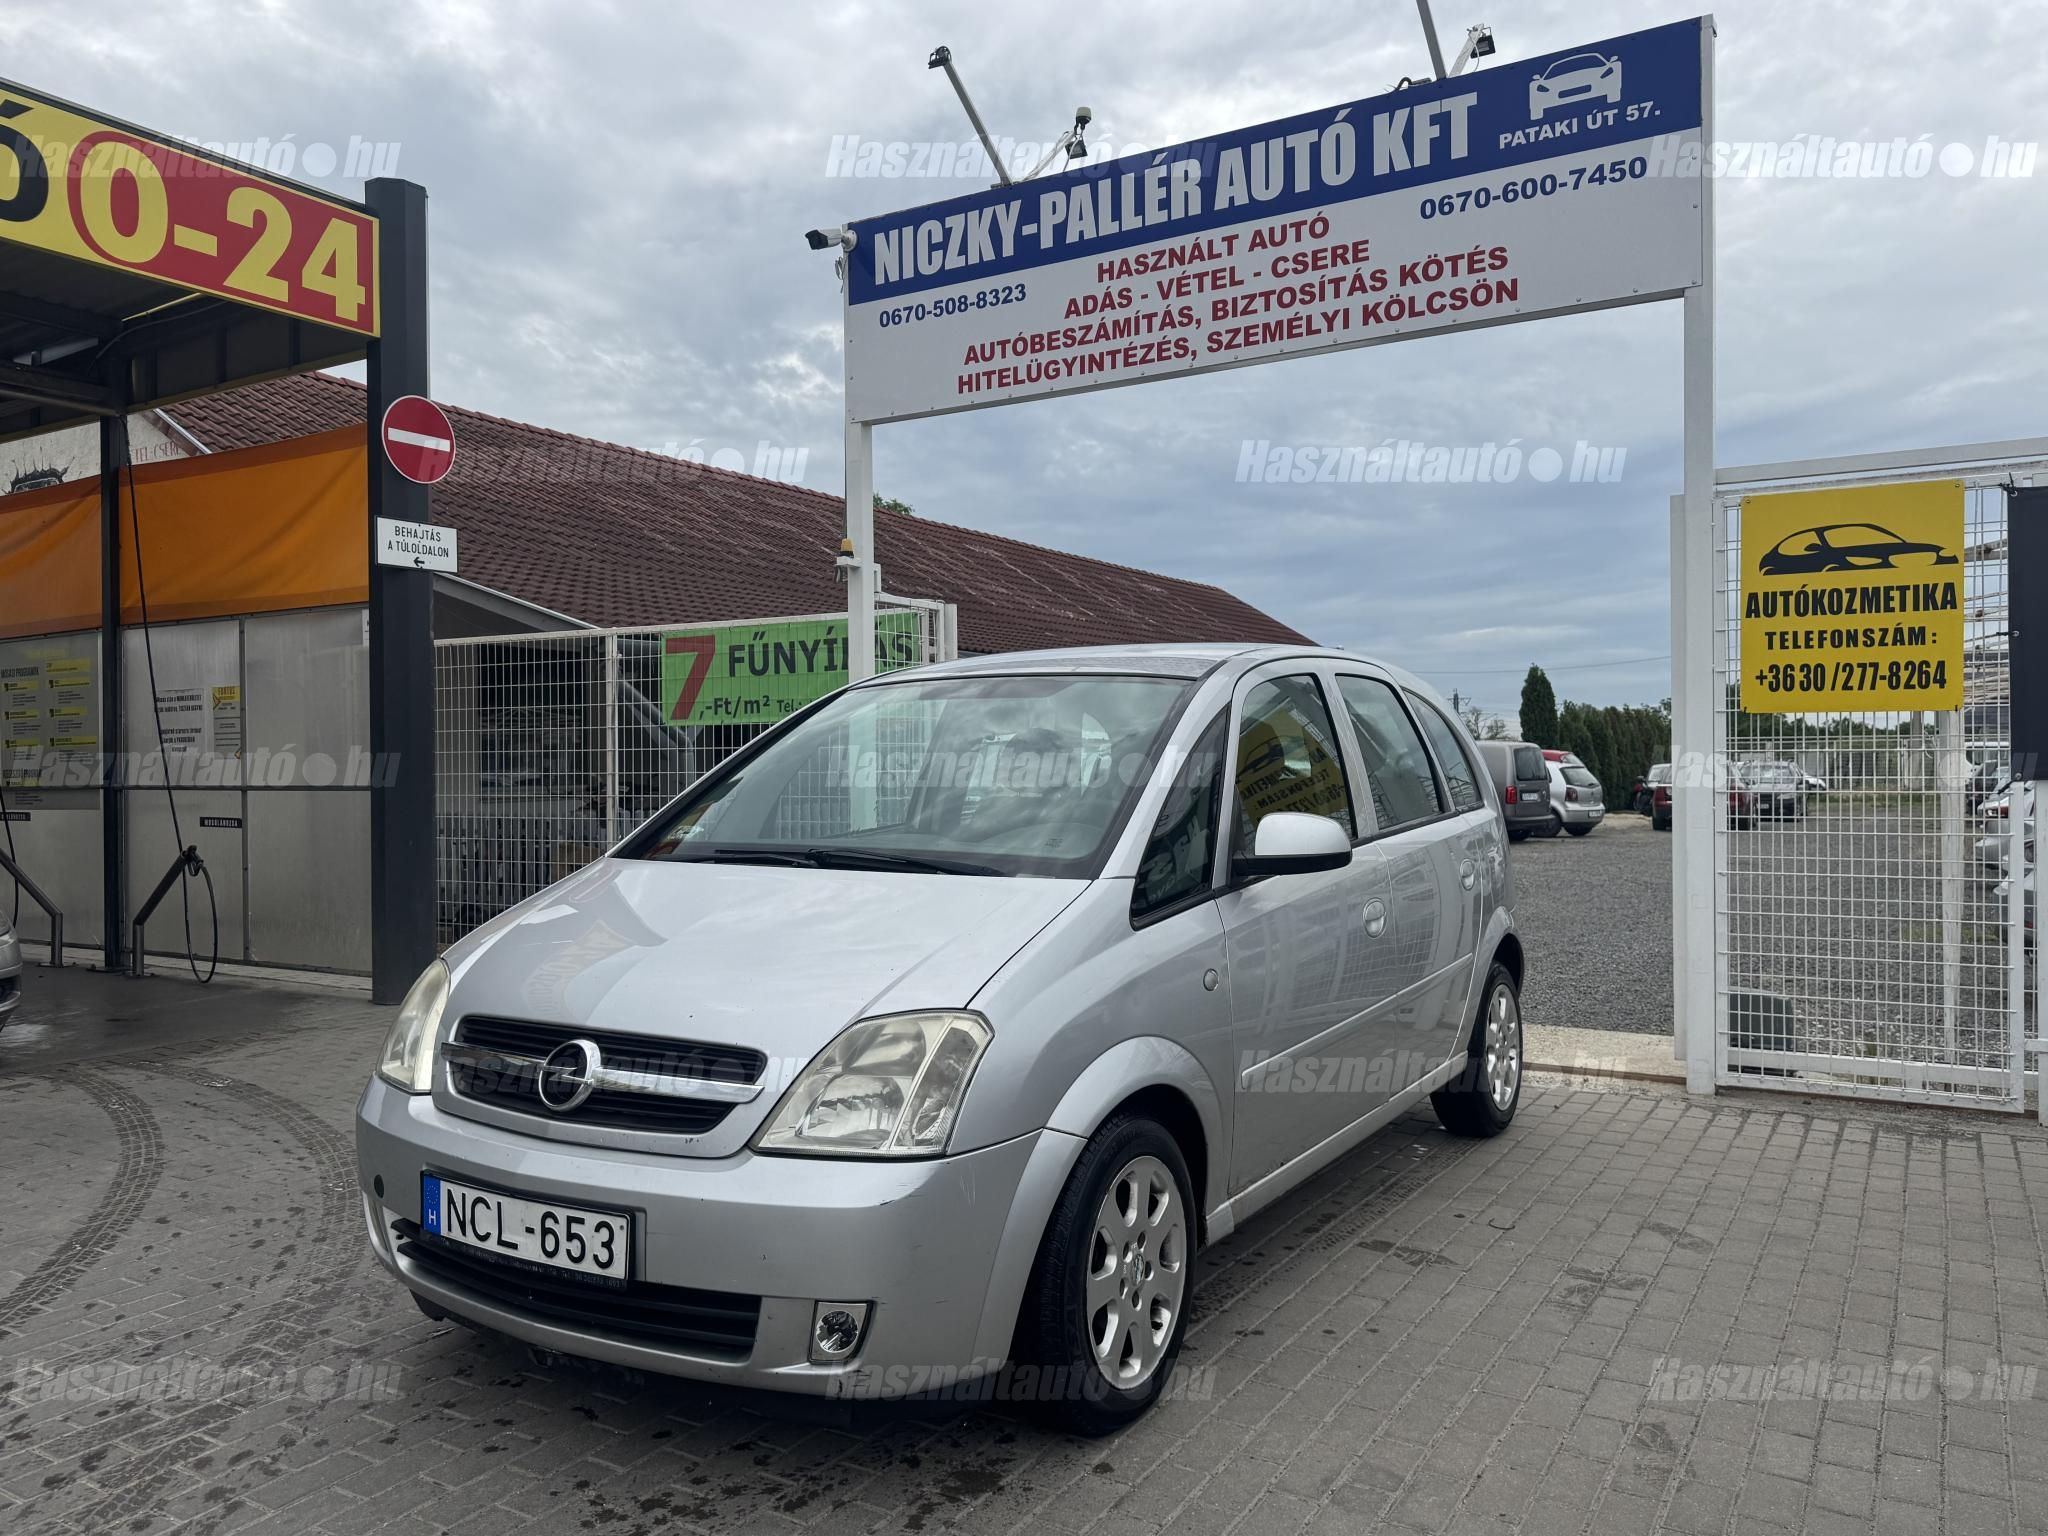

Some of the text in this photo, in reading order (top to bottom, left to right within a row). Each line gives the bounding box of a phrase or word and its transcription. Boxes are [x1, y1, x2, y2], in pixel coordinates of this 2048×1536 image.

[1499, 101, 1661, 150] PATAKI ÚT 57.
[874, 91, 1478, 286] NICZKY-PALLÉR AUTÓ KFT
[1420, 156, 1648, 219] 0670-600-7450
[79, 141, 366, 322] 0-24
[1097, 211, 1330, 283] HASZNÁLT AUTÓ
[879, 283, 1027, 328] 0670-508-8323
[964, 244, 1509, 366] AUTÓBESZÁMÍTÁS, BIZTOSÍTÁS KÖTÉS
[1064, 285, 1133, 320] ADÁS
[1157, 264, 1244, 302] VÉTEL
[1271, 239, 1370, 279] CSERE
[957, 276, 1519, 395] HITELÜGYINTÉZÉS, SZEMÉLYI KÖLCSÖN
[387, 539, 449, 558] A TÚLOLDALON
[394, 525, 441, 542] BEHAJTÁS
[1745, 581, 1958, 619] AUTÓKOZMETIKA
[729, 620, 913, 678] FŰNYÍÁS
[1765, 622, 1938, 651] TELEFONSZÁM:
[428, 1209, 437, 1226] H
[447, 1188, 615, 1269] NCL-653
